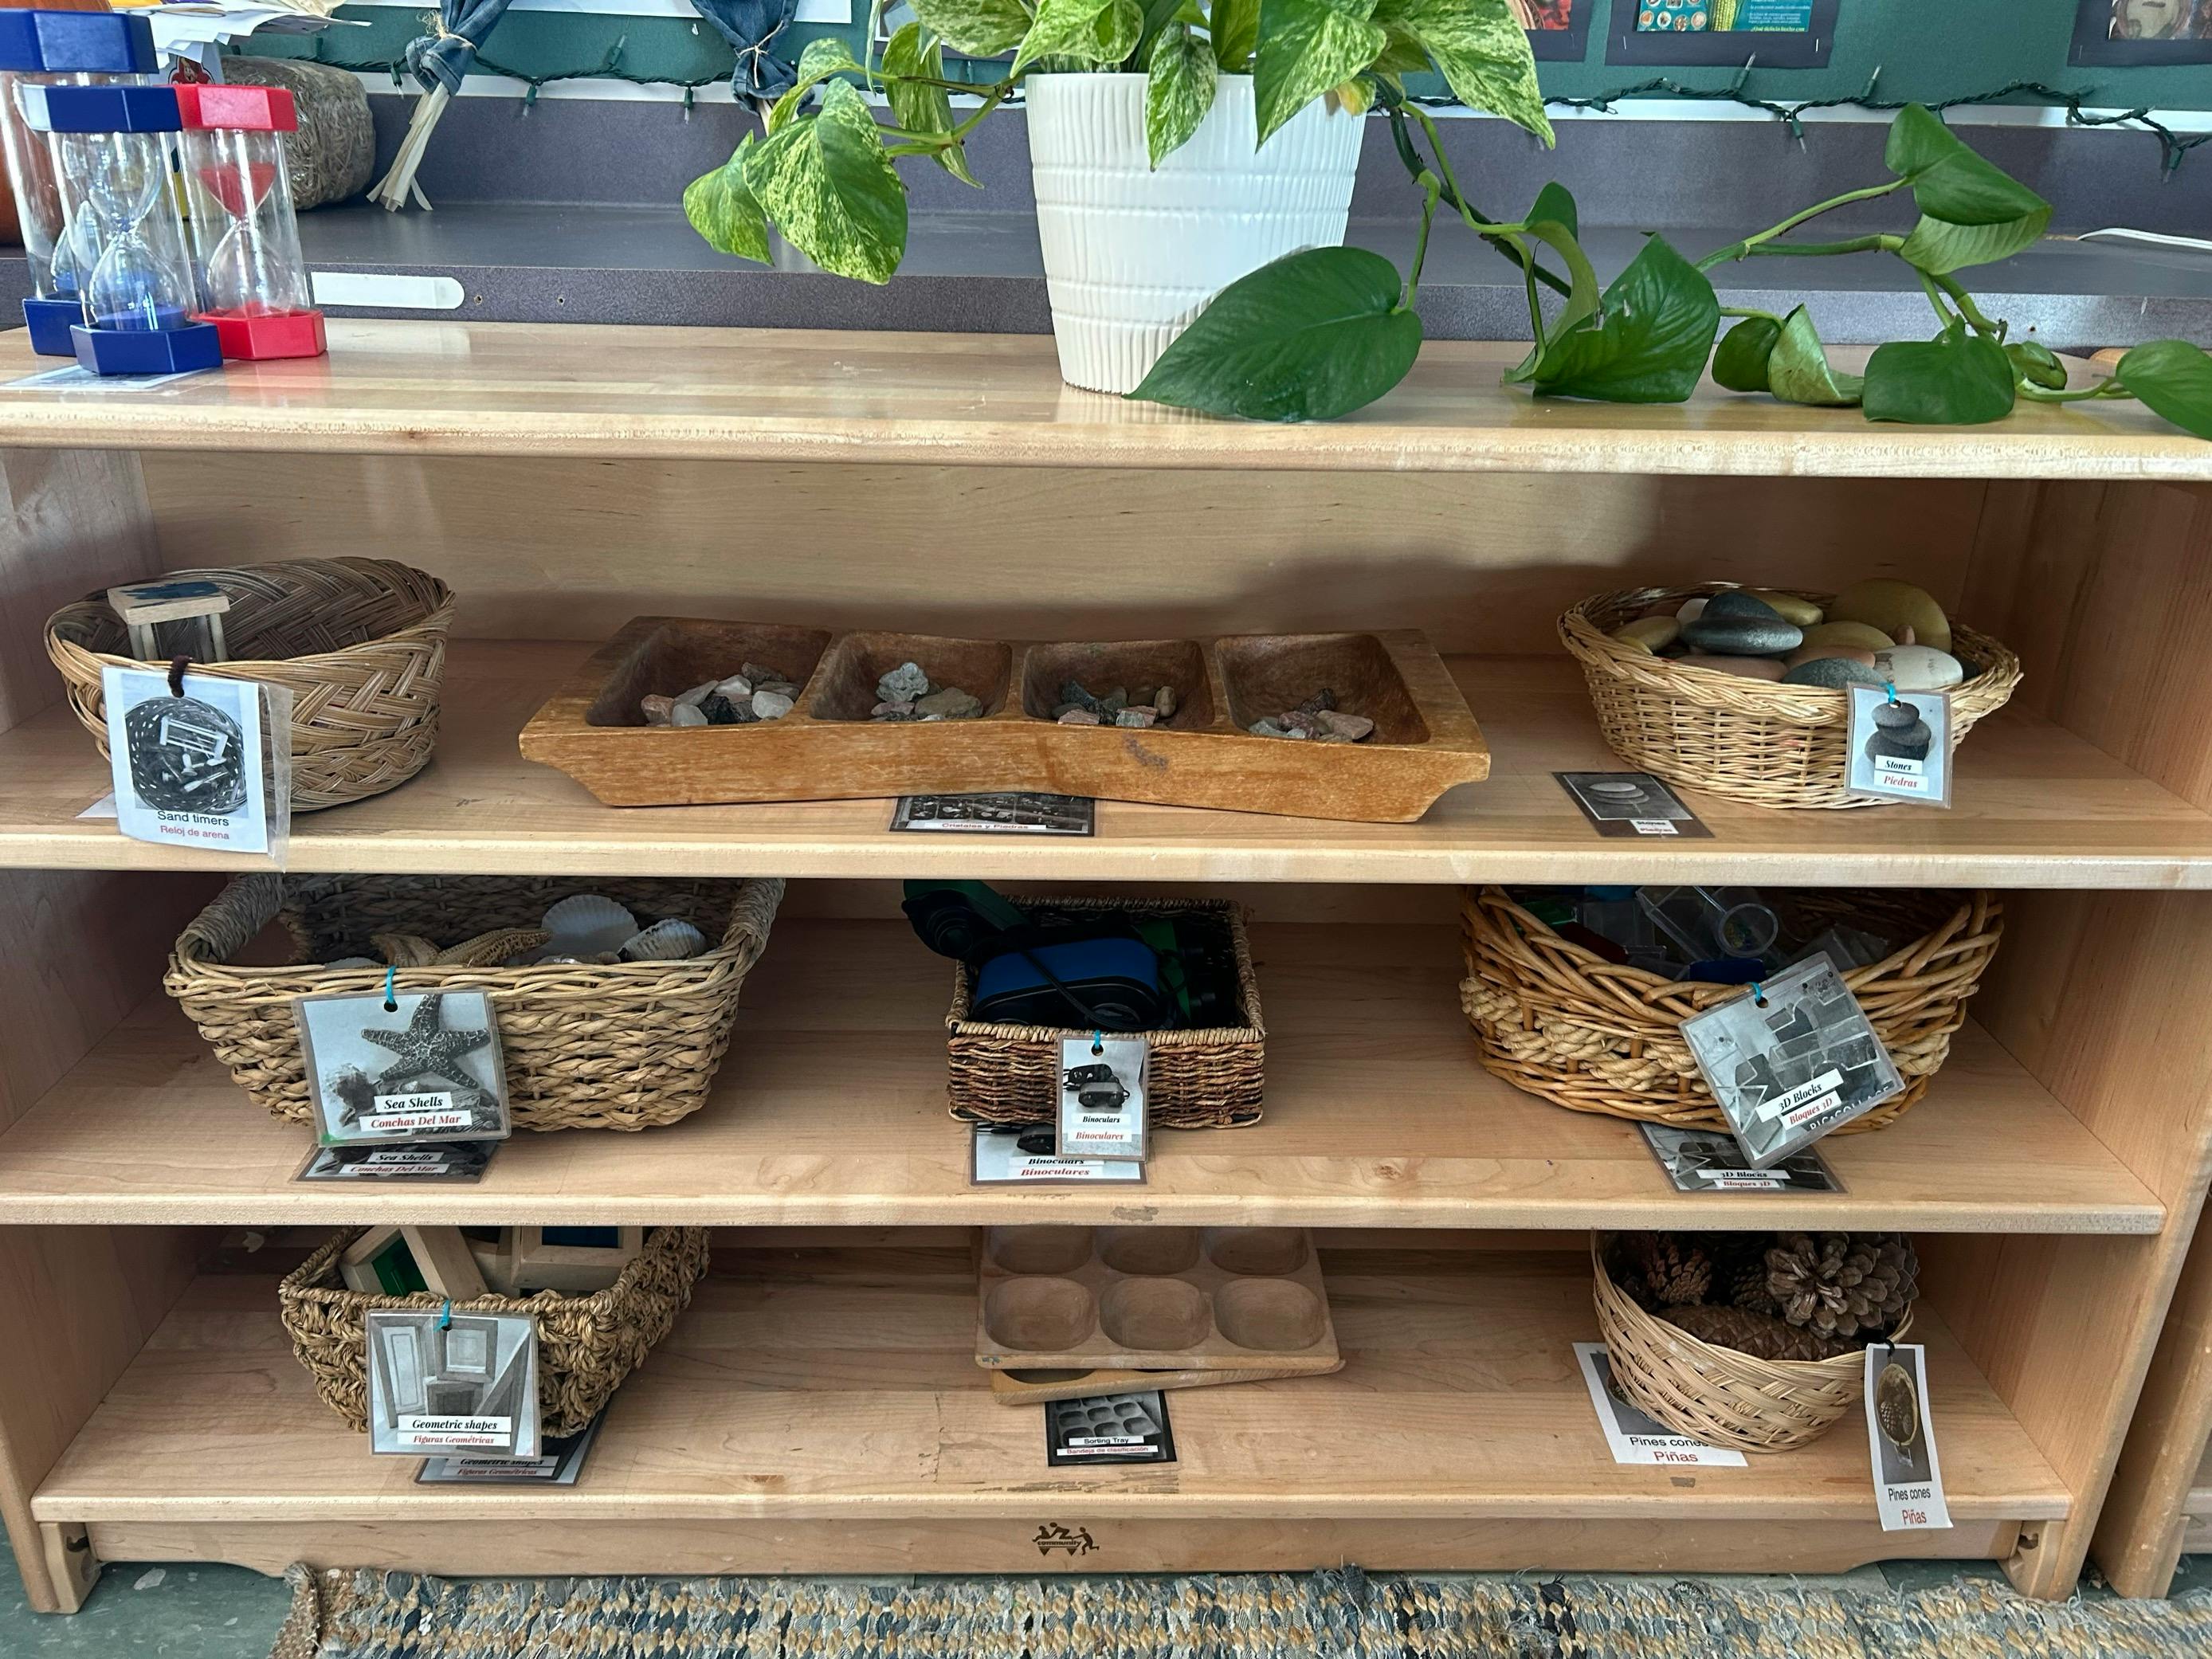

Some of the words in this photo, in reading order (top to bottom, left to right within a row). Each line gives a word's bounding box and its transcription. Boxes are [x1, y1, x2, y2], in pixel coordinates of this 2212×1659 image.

[1885, 759, 1912, 771] Stones
[1884, 775, 1918, 788] Piedras
[157, 810, 189, 822] Sand
[192, 814, 229, 826] timers
[160, 825, 185, 837] Reloj
[188, 828, 199, 837] de
[202, 831, 229, 840] arena
[384, 1098, 406, 1110] Sea
[408, 1096, 443, 1108] Shells
[1778, 1096, 1791, 1112] 3D
[1793, 1084, 1822, 1103] Blocks
[1789, 1105, 1821, 1124] Bloques
[1822, 1097, 1833, 1110] 3D
[371, 1116, 415, 1128] Conchas
[418, 1115, 437, 1126] Del
[438, 1114, 462, 1125] Mar
[1076, 1131, 1124, 1140] Binoculares
[1021, 1167, 1090, 1176] Binoculares
[412, 1419, 463, 1430] Geometric
[464, 1419, 497, 1431] shapes
[413, 1435, 443, 1445] Figuras
[445, 1434, 494, 1445] Geométricas
[1629, 1437, 1666, 1447] Pines
[1653, 1451, 1699, 1463] Piñas
[1888, 1488, 1908, 1502] Pines
[1909, 1487, 1932, 1500] cones
[1901, 1508, 1927, 1526] Piñas
